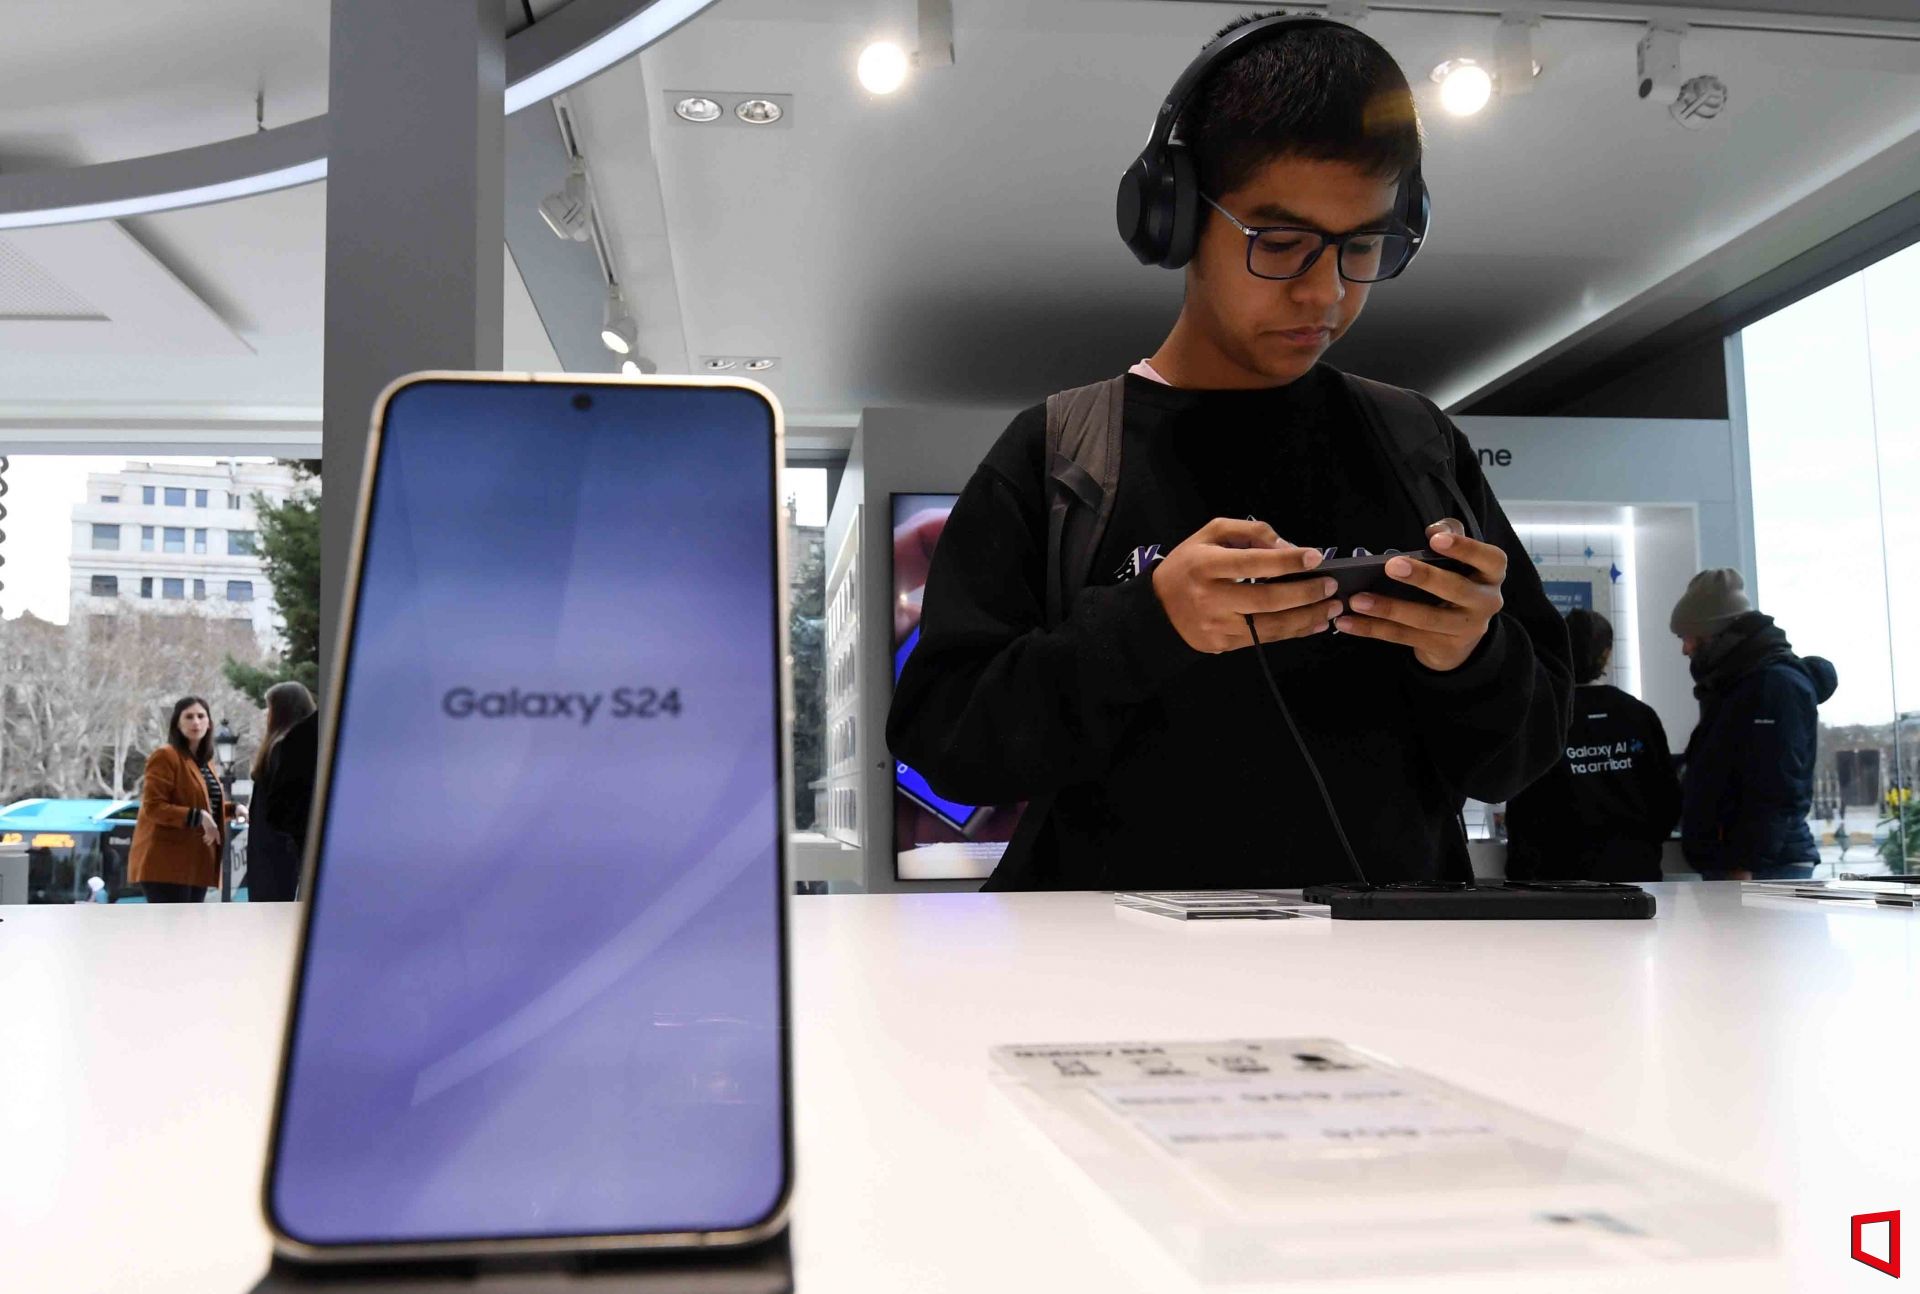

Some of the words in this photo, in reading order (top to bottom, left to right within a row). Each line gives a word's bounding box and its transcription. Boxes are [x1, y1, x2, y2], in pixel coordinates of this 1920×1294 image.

[1478, 448, 1512, 467] ne
[442, 686, 602, 726] Galaxy
[611, 686, 682, 718] S24
[1566, 745, 1611, 759] Galaxy
[1615, 741, 1627, 754] AI
[1570, 763, 1587, 774] ha
[1588, 757, 1632, 772] arribat
